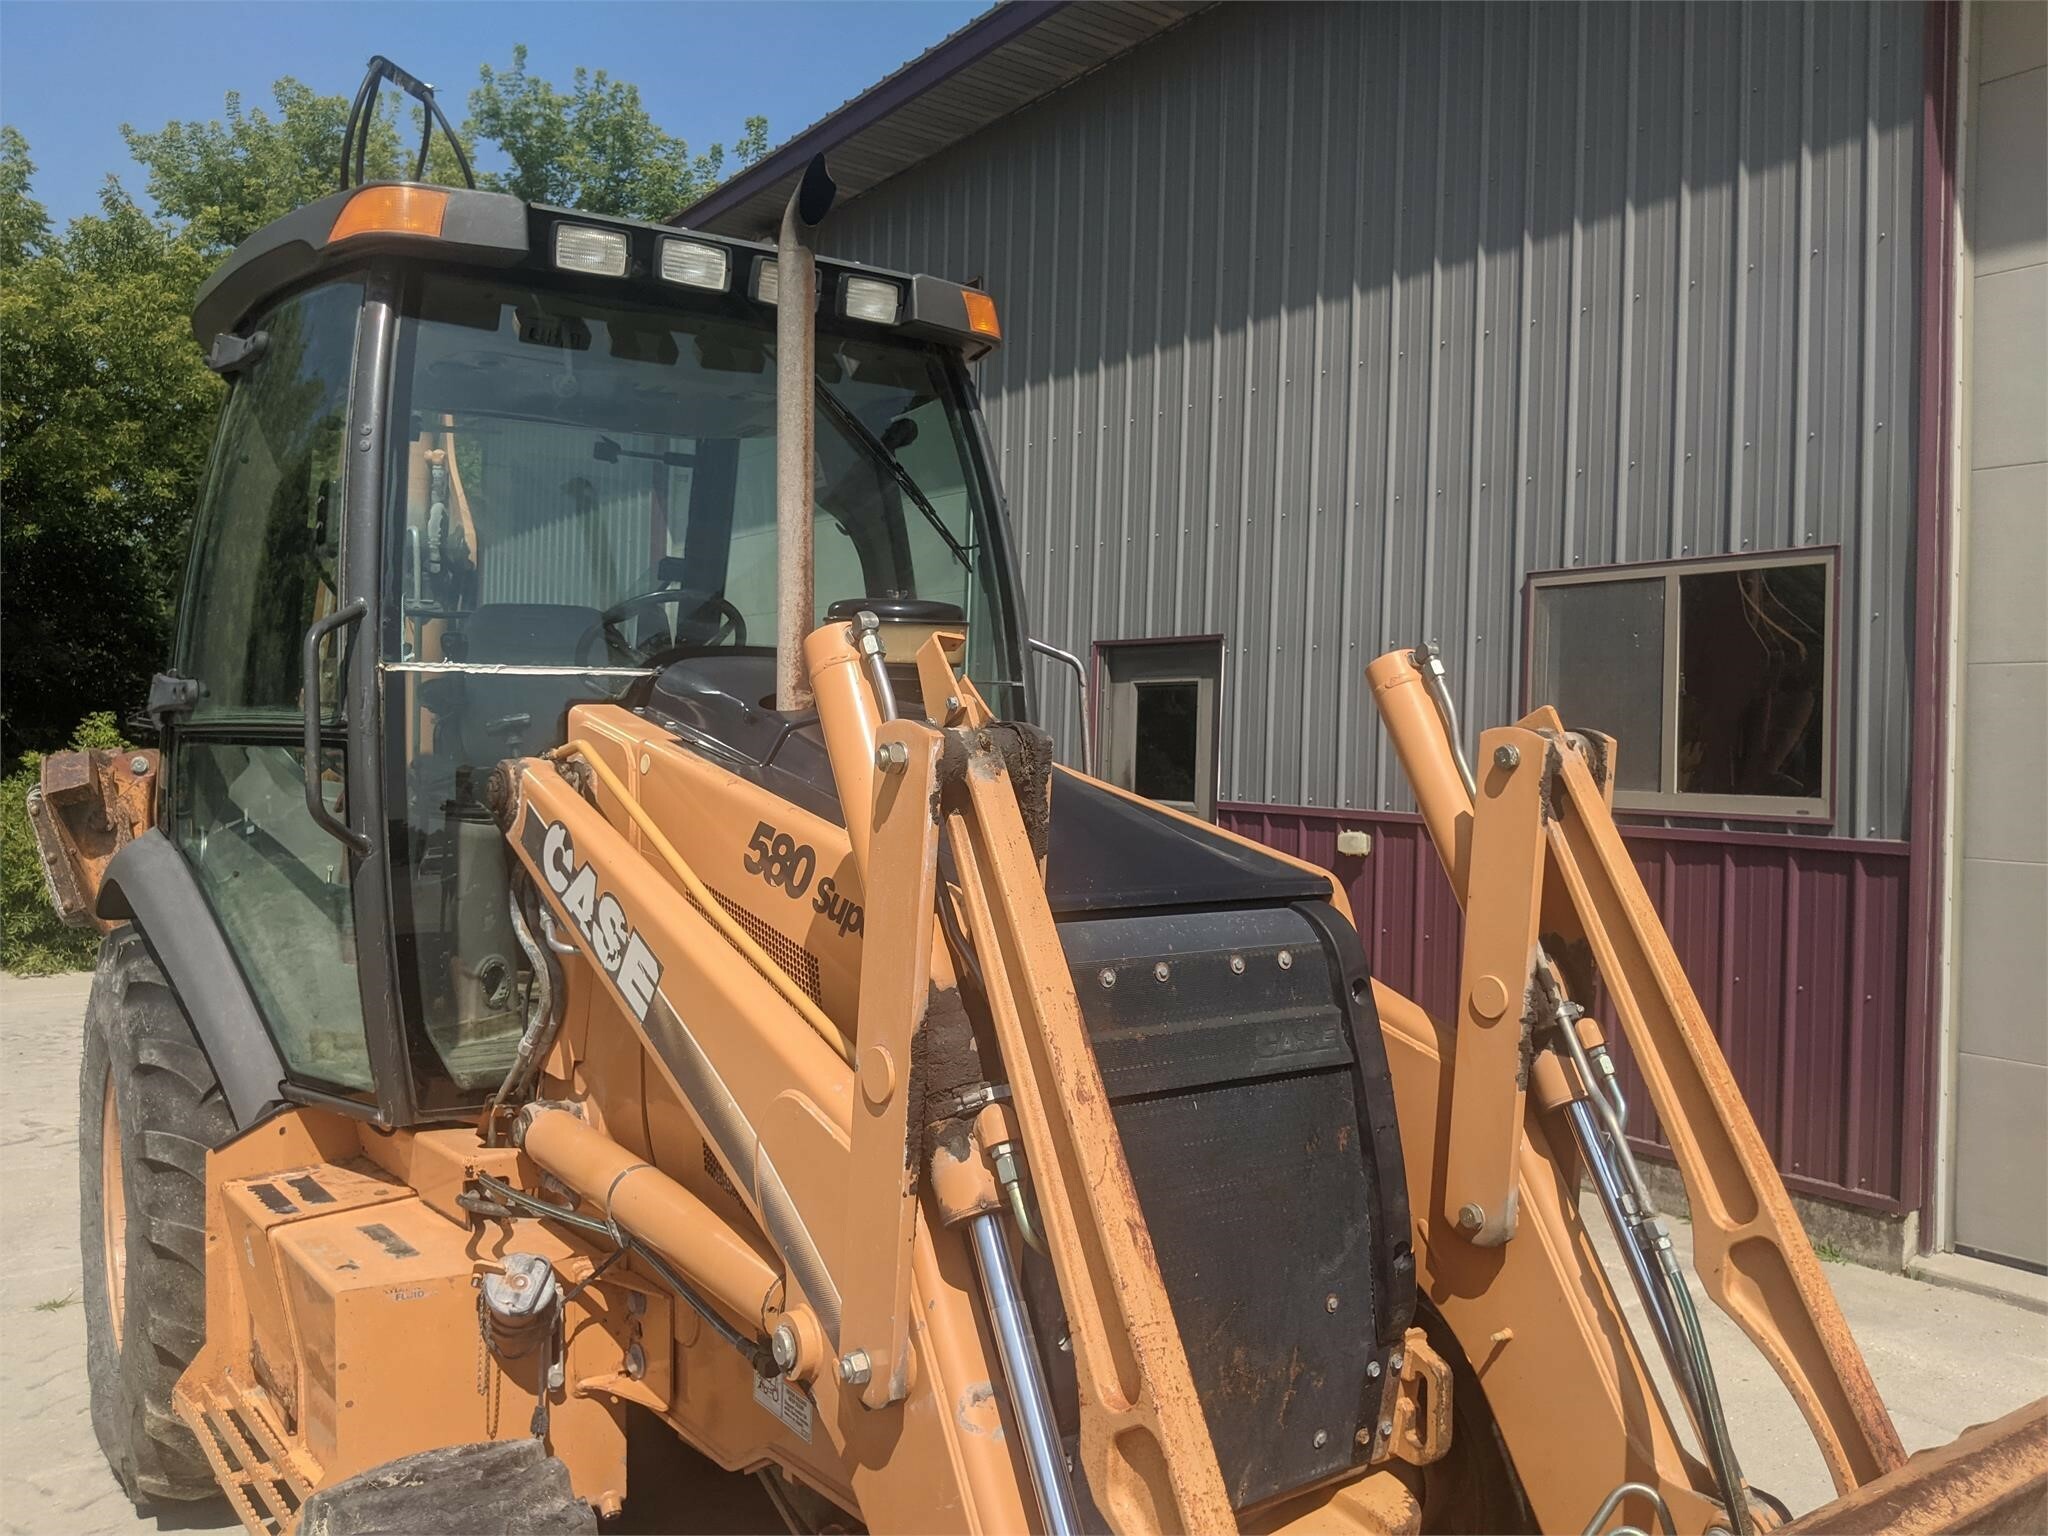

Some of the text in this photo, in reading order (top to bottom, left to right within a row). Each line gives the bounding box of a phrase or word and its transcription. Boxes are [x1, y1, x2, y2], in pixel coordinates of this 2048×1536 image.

[543, 821, 662, 1023] CASE
[744, 821, 865, 939] 580 Sup
